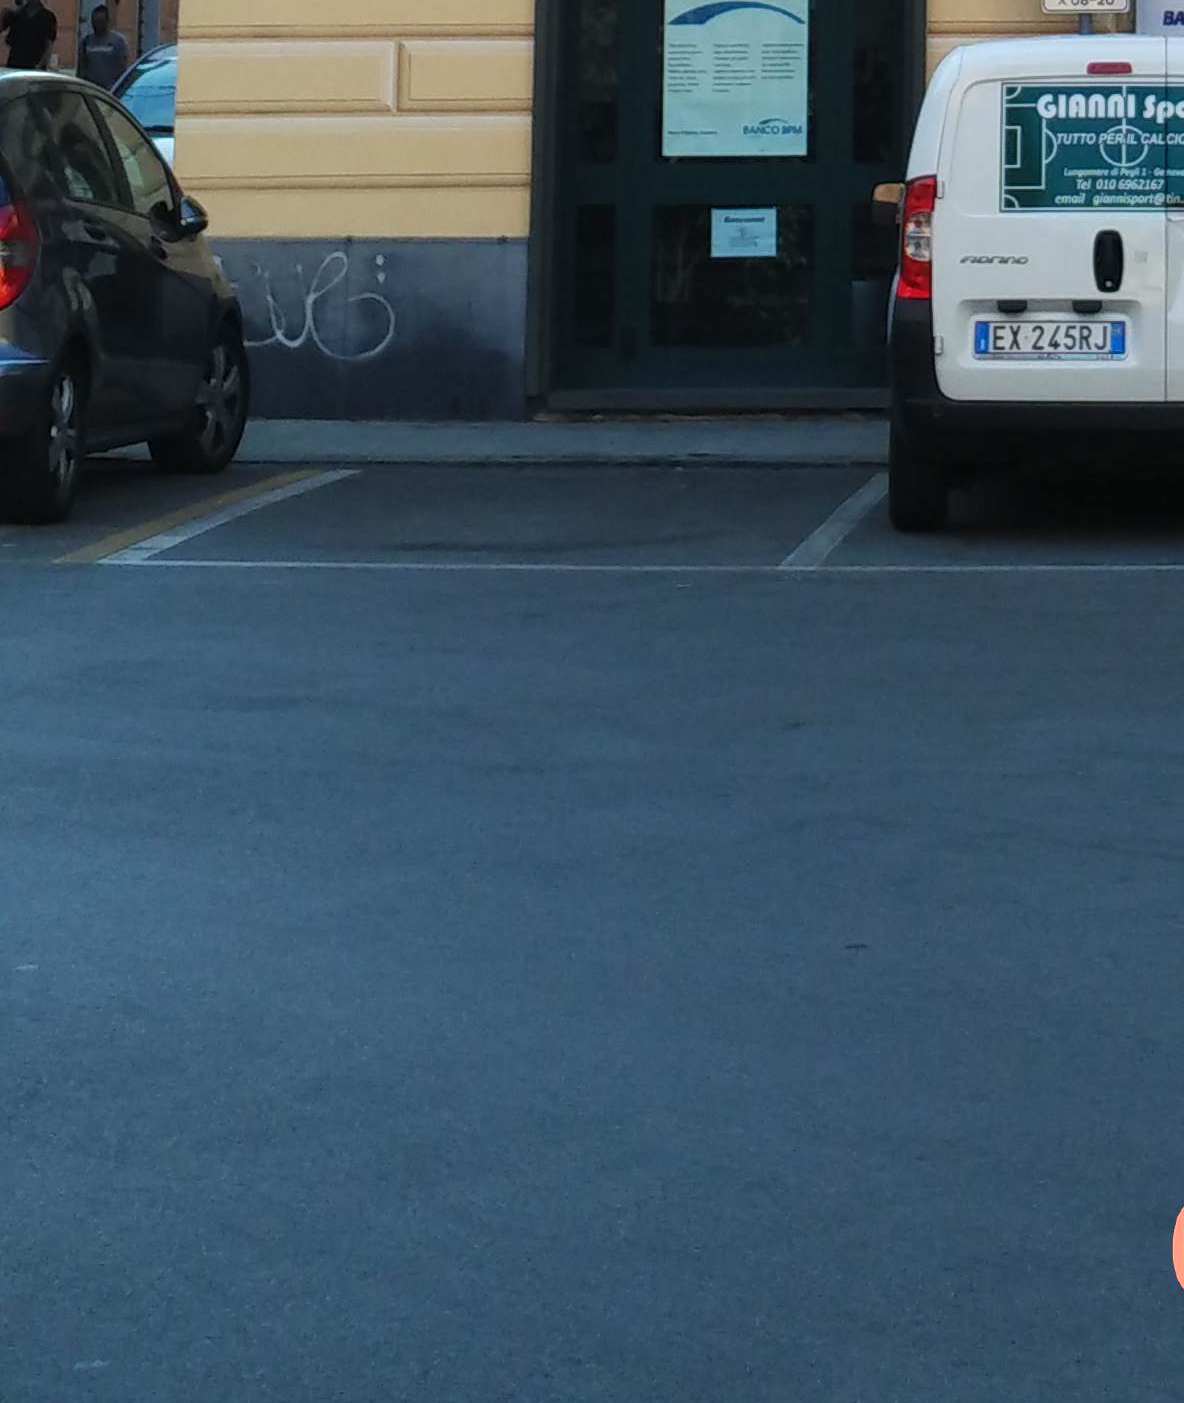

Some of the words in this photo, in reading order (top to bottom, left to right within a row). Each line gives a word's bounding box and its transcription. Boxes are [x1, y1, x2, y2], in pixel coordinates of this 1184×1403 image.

[1036, 94, 1136, 119] GIANNI
[743, 125, 780, 135] BANCO
[1056, 133, 1096, 145] TUTTO
[1098, 133, 1124, 145] PER
[1125, 133, 1138, 145] IL
[1075, 179, 1092, 190] Tel
[1095, 179, 1116, 190] 010
[1118, 179, 1165, 191] 6962167
[1054, 193, 1086, 204] email
[992, 325, 1021, 351] EX
[1031, 325, 1108, 351] 245RJ
